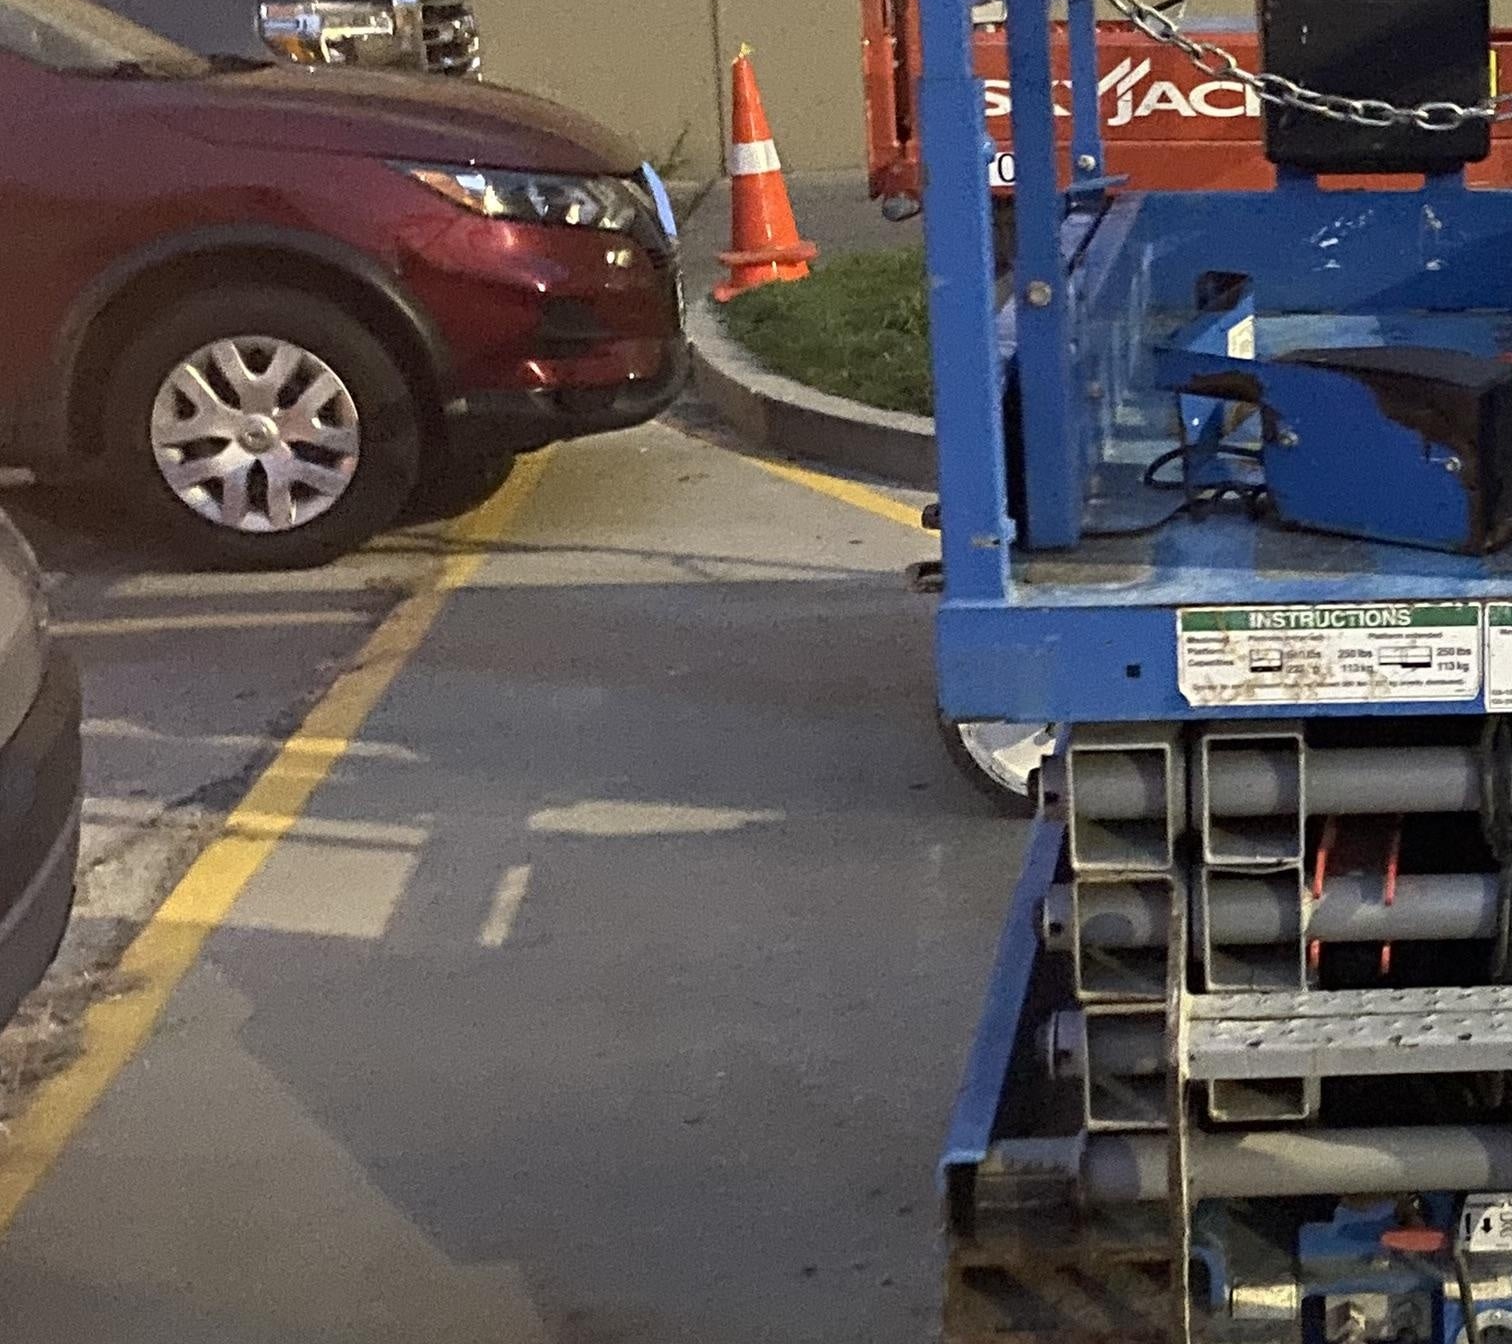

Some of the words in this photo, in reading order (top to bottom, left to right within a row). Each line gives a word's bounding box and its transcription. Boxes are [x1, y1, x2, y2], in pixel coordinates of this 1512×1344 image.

[1249, 609, 1412, 628] INSTRUCTIONS
[1436, 647, 1455, 656] 250
[1457, 647, 1472, 656] lbs
[1438, 662, 1455, 671] 113
[1456, 661, 1470, 673] kg
